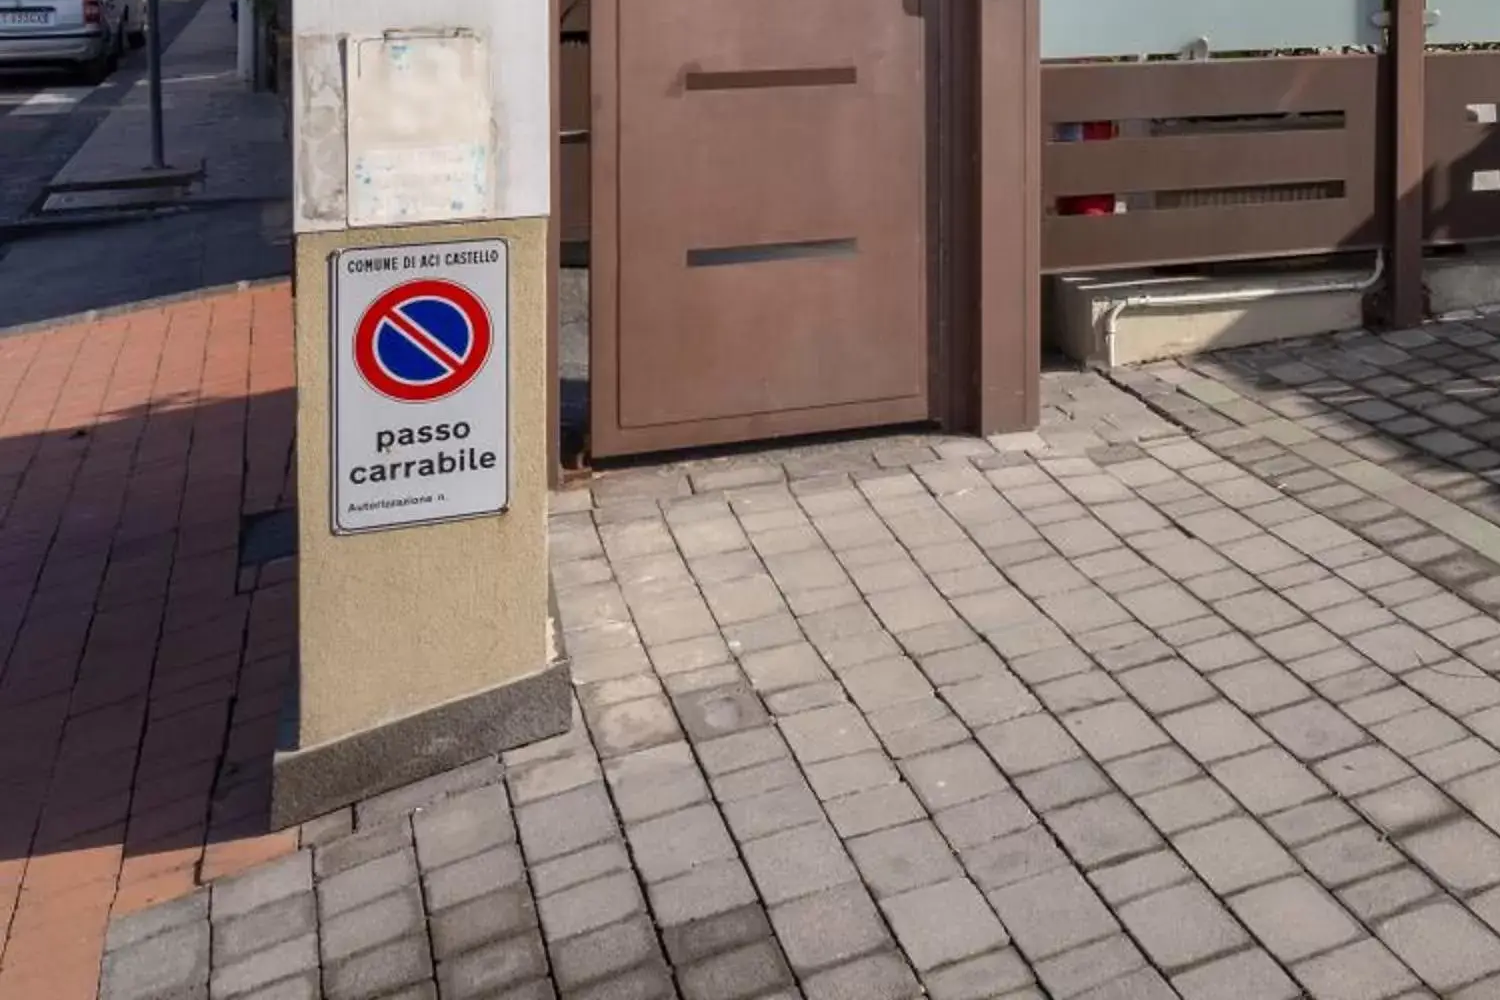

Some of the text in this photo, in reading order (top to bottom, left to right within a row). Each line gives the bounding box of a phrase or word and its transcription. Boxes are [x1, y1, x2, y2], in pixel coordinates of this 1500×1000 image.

[347, 249, 499, 273] COMUNE DI ACI CASTELLO
[376, 420, 471, 452] passo
[349, 447, 497, 485] carrabile
